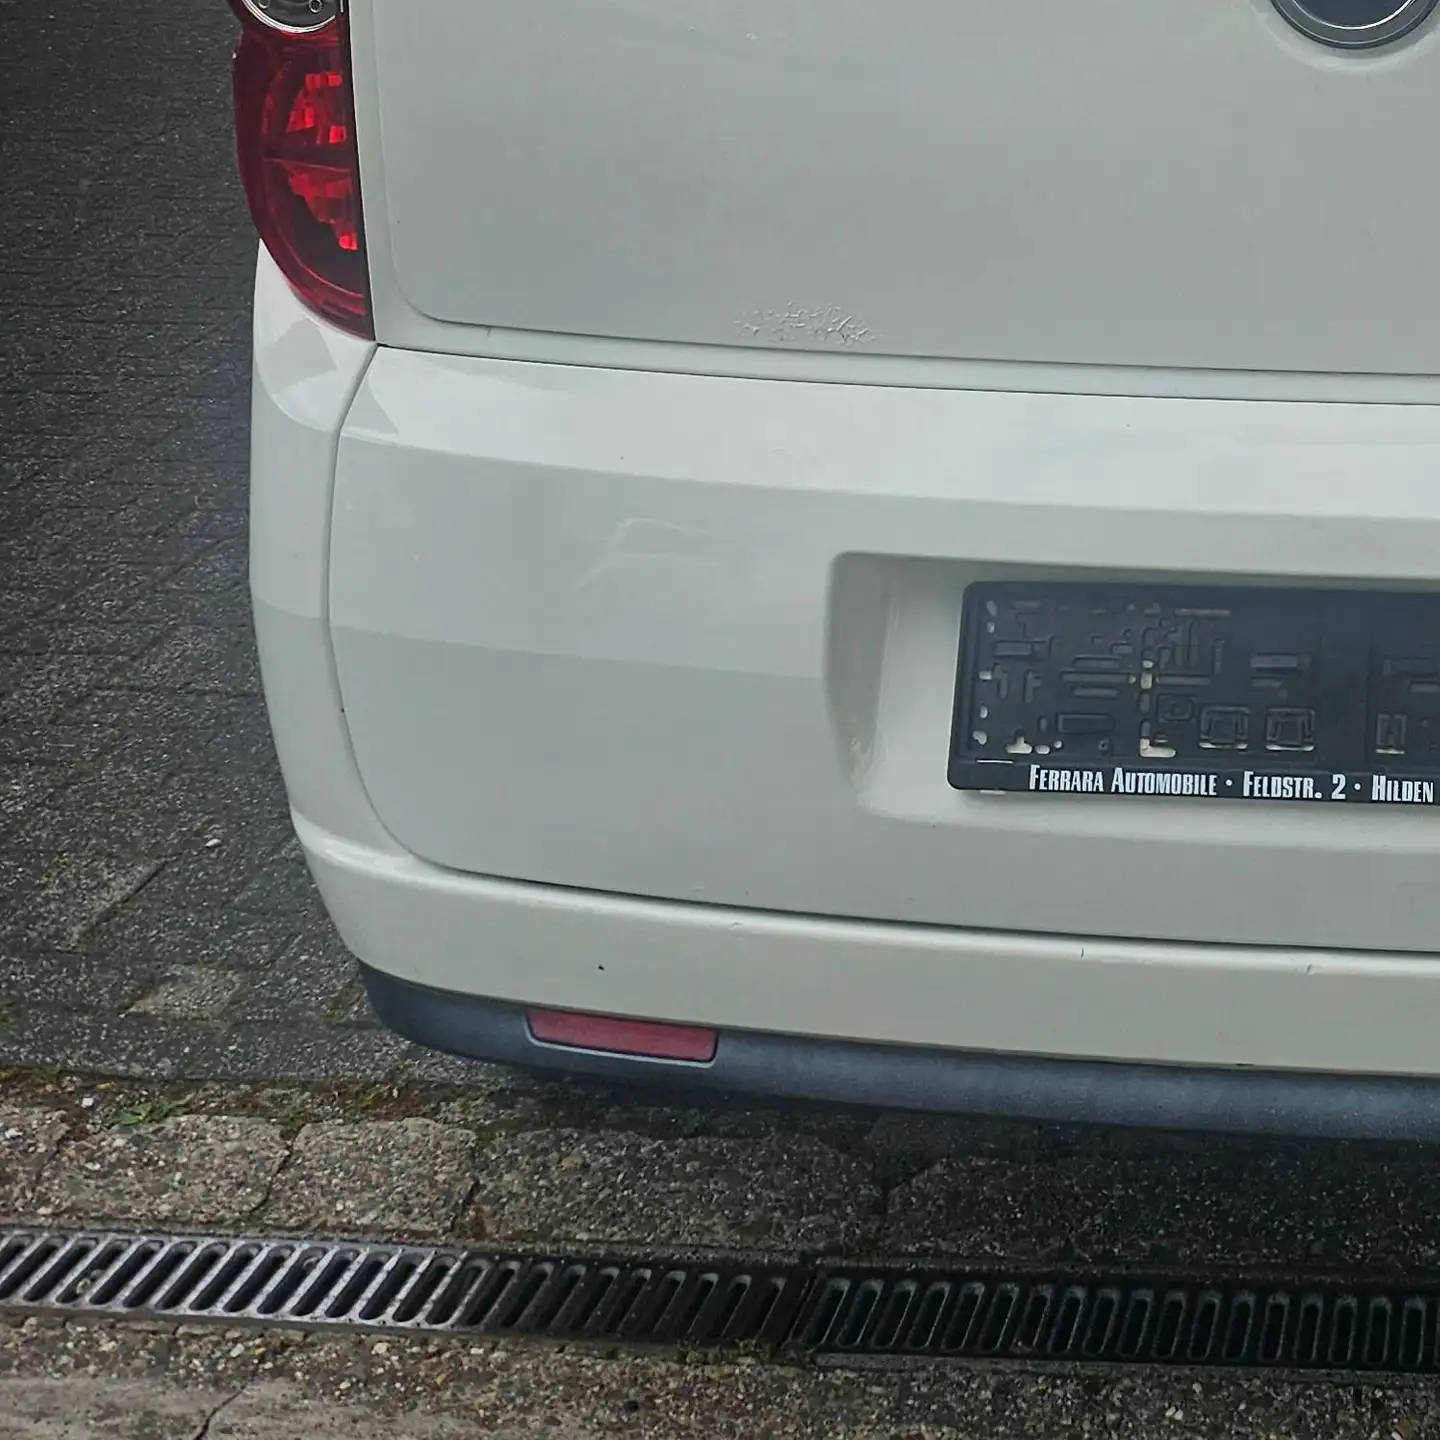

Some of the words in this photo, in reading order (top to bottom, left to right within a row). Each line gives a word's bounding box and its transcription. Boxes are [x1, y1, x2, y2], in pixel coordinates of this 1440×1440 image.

[1029, 765, 1104, 792] FERRARA
[1111, 767, 1217, 796] AUTOMOBILE
[1243, 771, 1322, 799] FELDSTR.
[1331, 774, 1347, 800] 2
[1371, 775, 1434, 803] HILDEN
